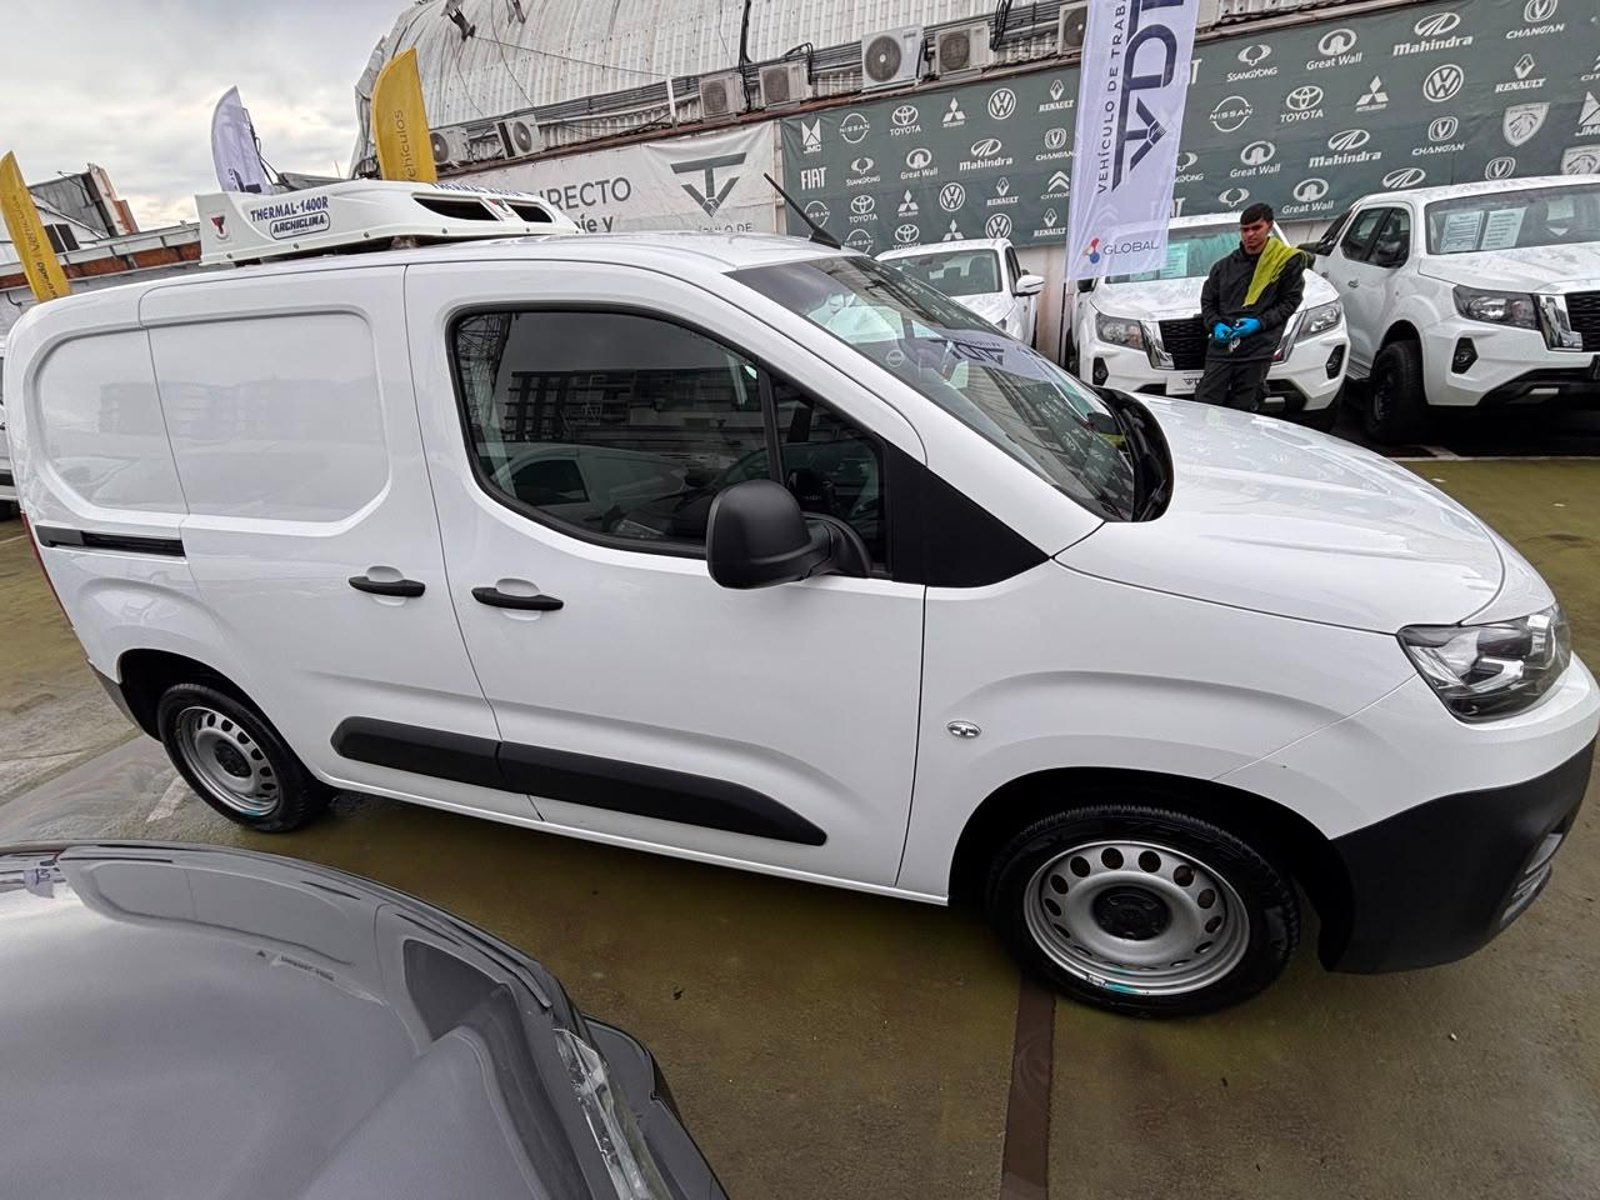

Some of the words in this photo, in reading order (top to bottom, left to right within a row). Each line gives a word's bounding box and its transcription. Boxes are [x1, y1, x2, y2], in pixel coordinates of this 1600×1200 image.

[1111, 0, 1127, 59] TRAB
[1506, 24, 1565, 39] CHANGAN
[1393, 35, 1473, 56] Mahindra
[1306, 58, 1336, 71] Great
[1338, 52, 1363, 66] Wall
[1107, 66, 1119, 92] DE
[1226, 66, 1278, 82] SSANGYONG
[1494, 78, 1546, 93] RENAULT
[1039, 99, 1074, 112] RENAULT
[1209, 108, 1253, 120] NISSAN
[1280, 110, 1324, 123] TOYOTA
[840, 123, 870, 133] NISSAN
[890, 124, 922, 136] TOYOTA
[1411, 144, 1465, 155] CHANGAN
[959, 156, 1013, 171] Mahindra
[1308, 150, 1382, 168] Mahindra
[800, 167, 827, 190] FIAT
[900, 170, 921, 180] Great
[921, 167, 938, 177] Wall
[1230, 168, 1257, 179] Great
[1259, 164, 1281, 175] Wall
[1282, 203, 1308, 215] Great
[1311, 201, 1334, 212] Wall
[849, 213, 879, 224] TOYOTA
[1103, 240, 1160, 255] GLOBAL
